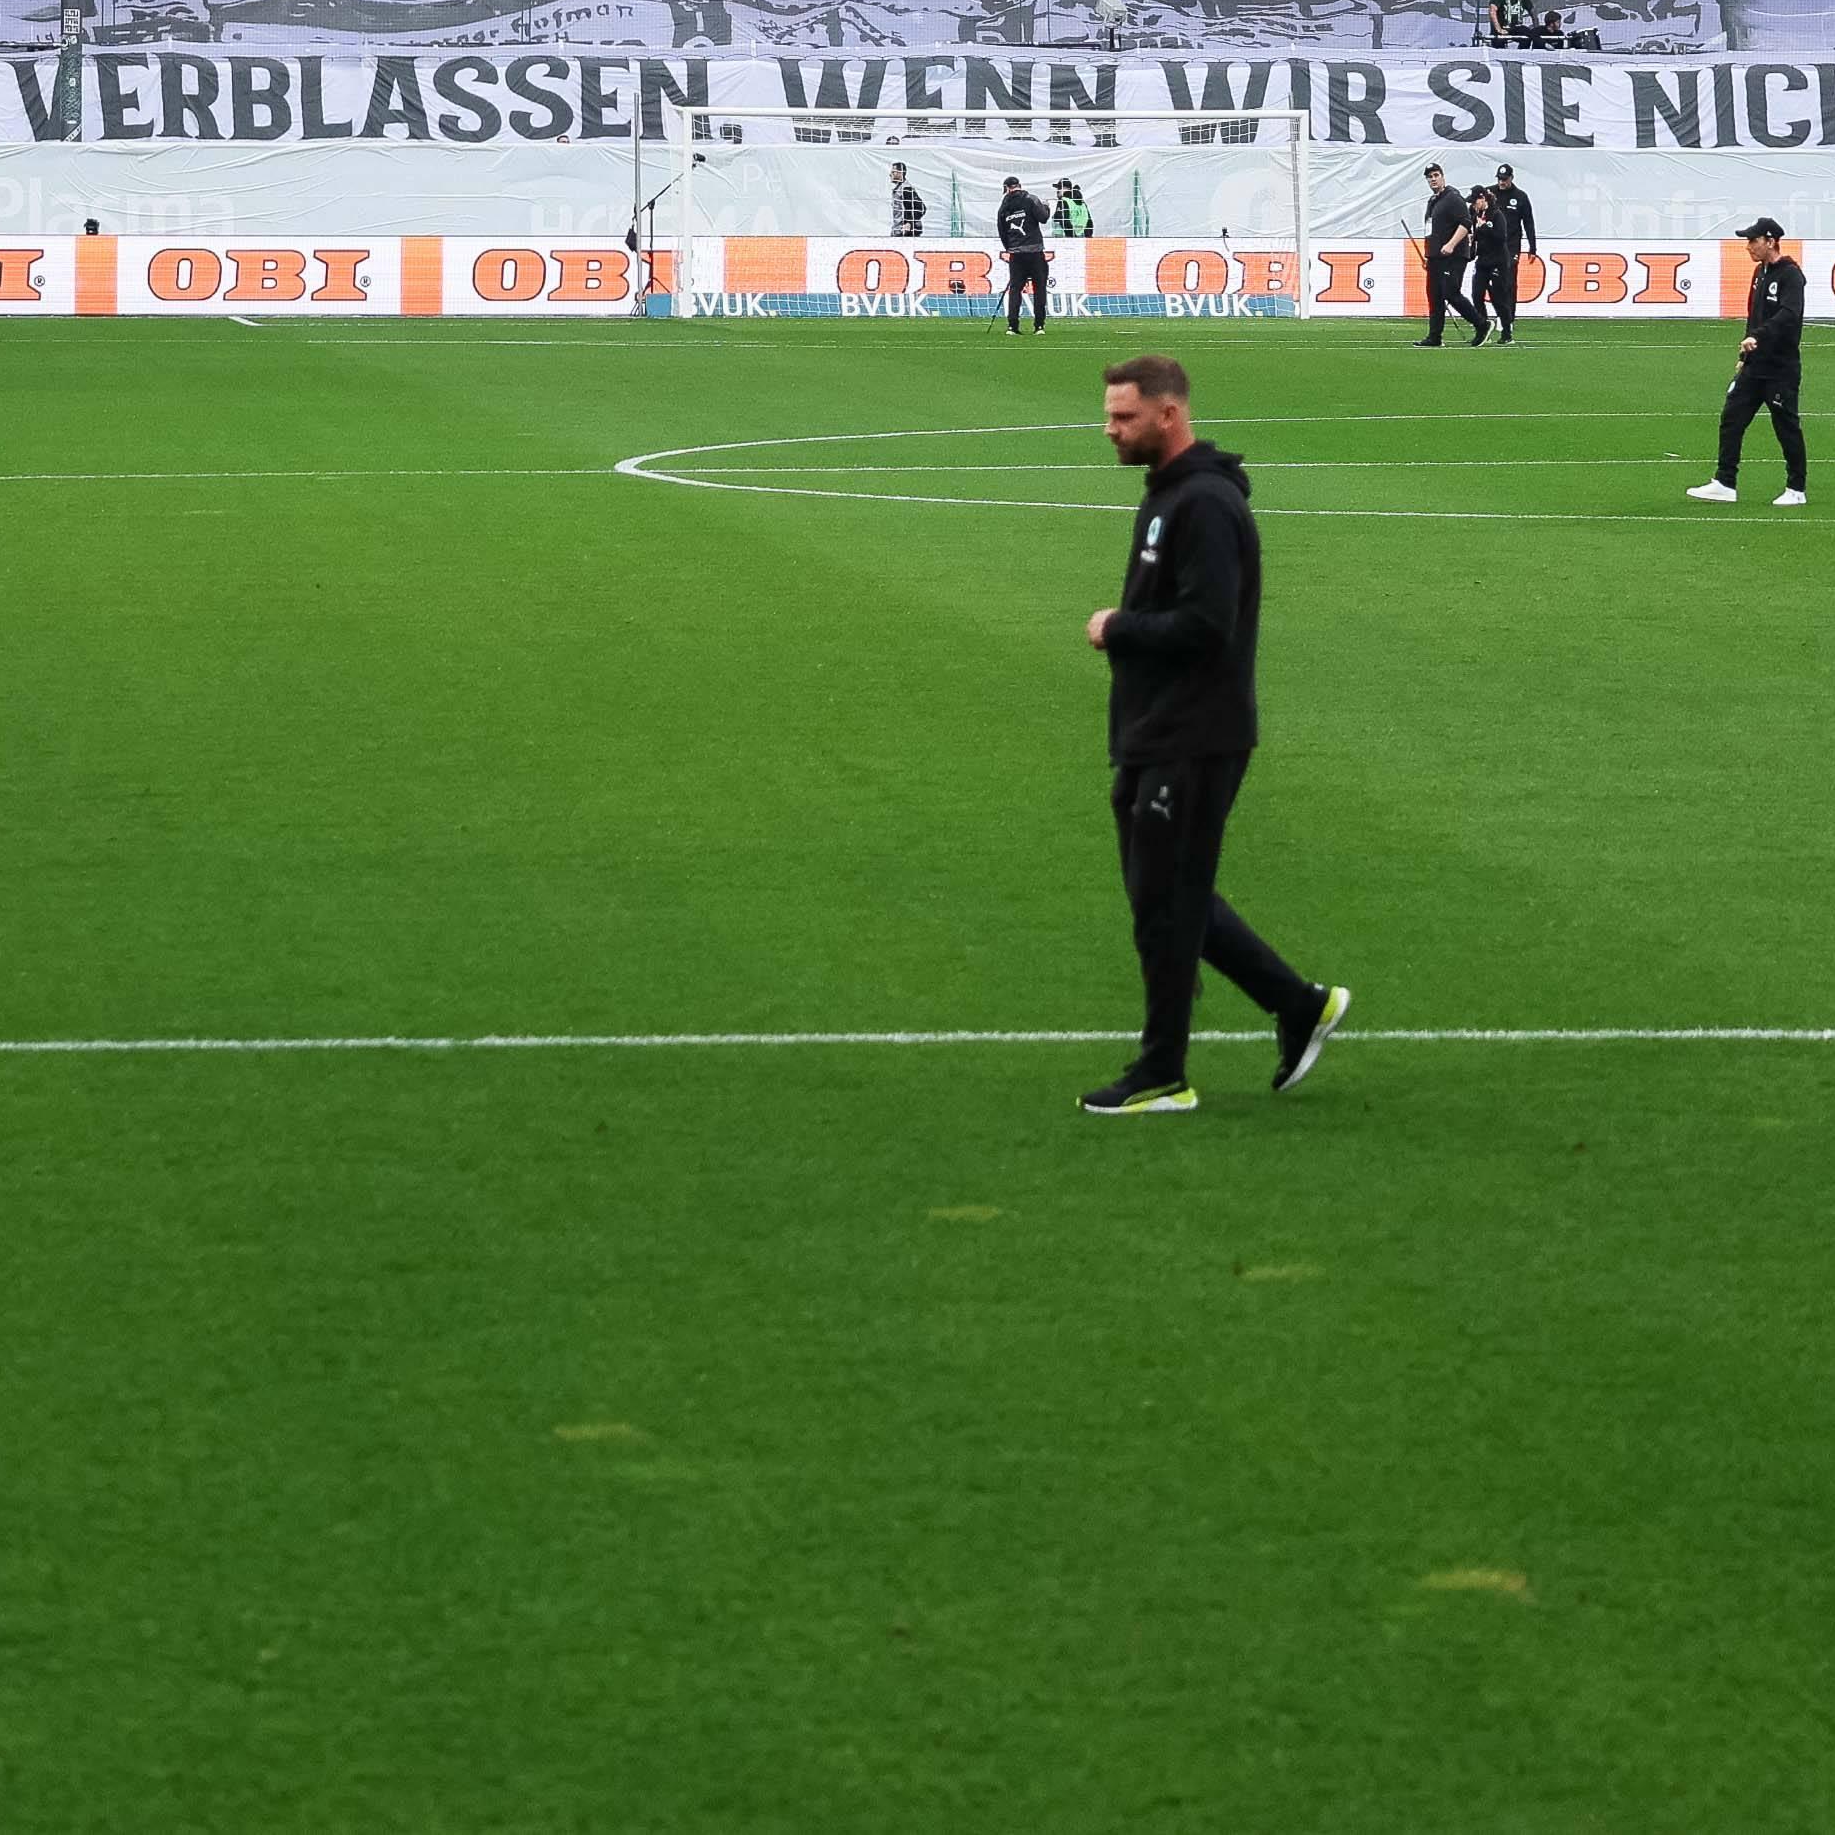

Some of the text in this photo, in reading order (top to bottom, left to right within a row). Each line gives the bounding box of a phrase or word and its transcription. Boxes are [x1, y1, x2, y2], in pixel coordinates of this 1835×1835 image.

[780, 57, 1119, 148] WENN
[1163, 59, 1394, 146] WIR
[1430, 60, 1596, 147] SIE
[147, 248, 372, 301] OBI
[839, 292, 940, 318] BVUK.
[1164, 292, 1264, 318] BVUK.
